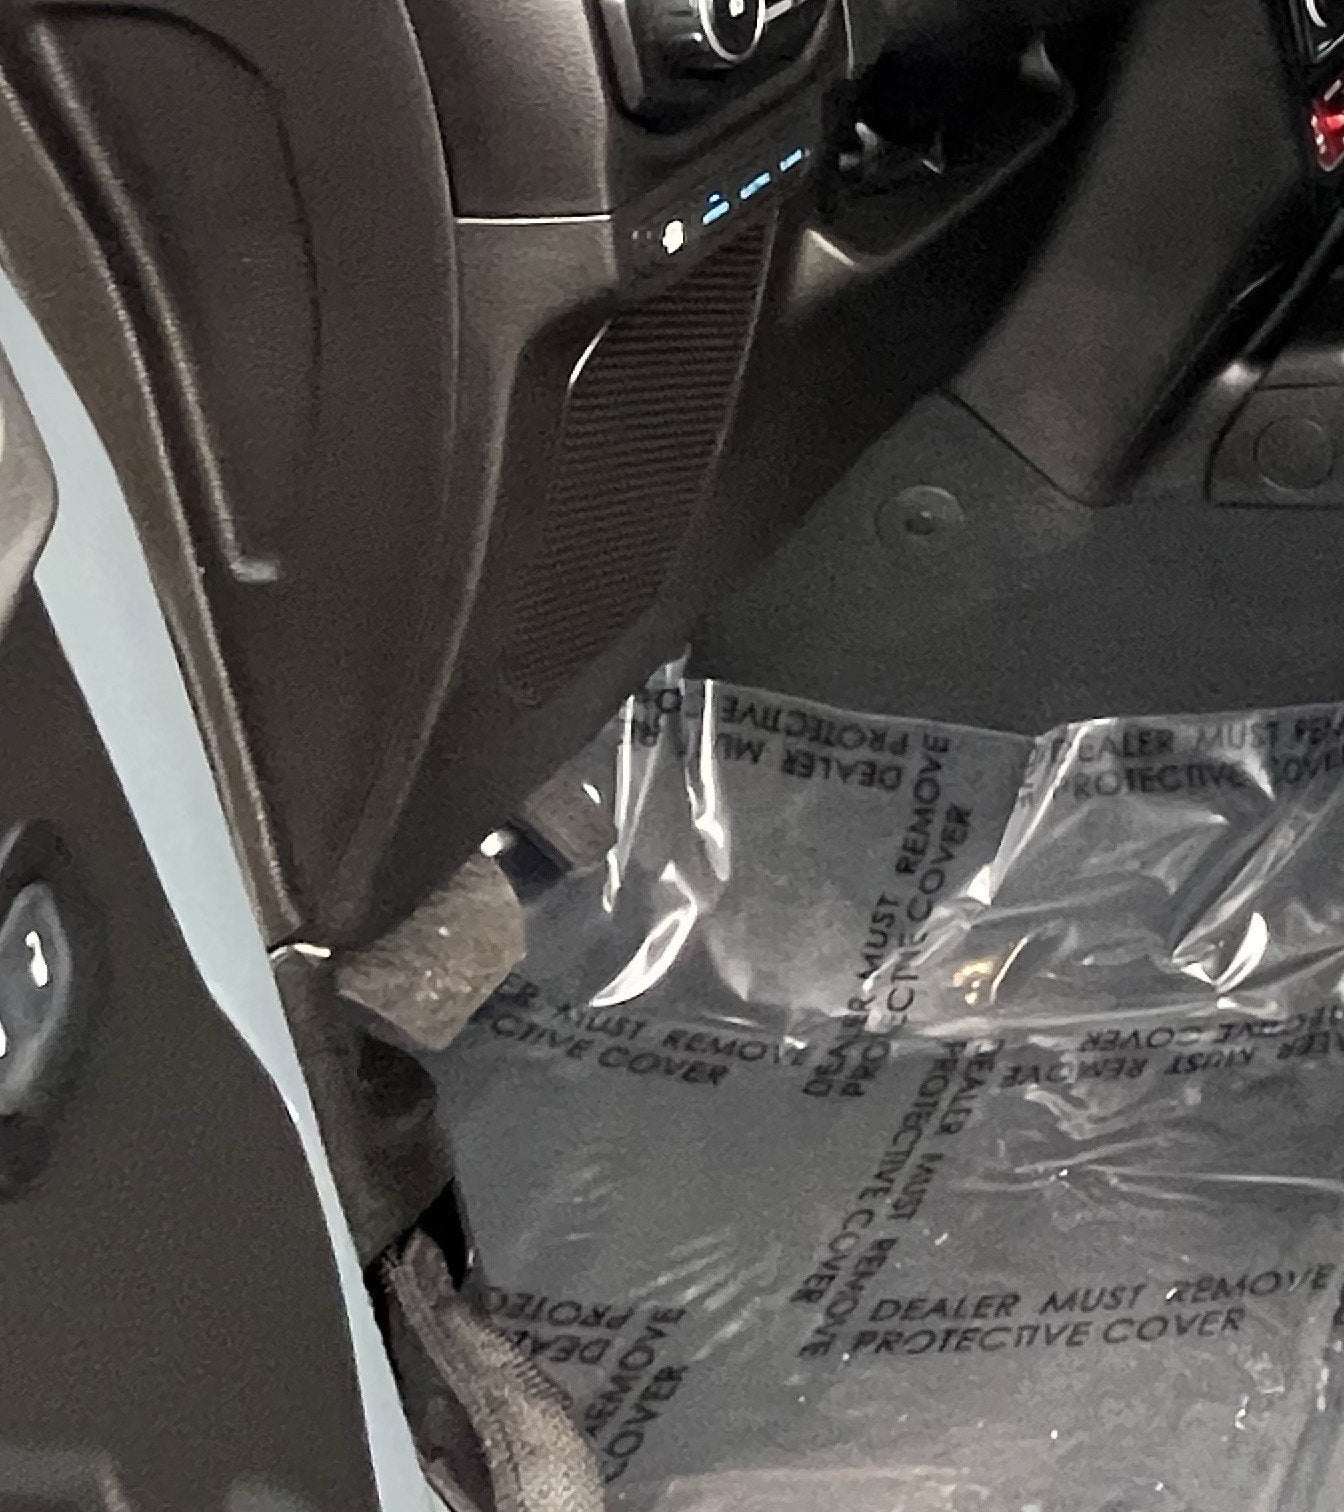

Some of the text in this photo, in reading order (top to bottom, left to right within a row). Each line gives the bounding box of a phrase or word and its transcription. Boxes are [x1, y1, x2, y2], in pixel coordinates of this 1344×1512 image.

[719, 694, 910, 756] PROTECTIVE
[780, 747, 904, 791] DEALER
[856, 890, 900, 983] MUST
[896, 732, 951, 876] REMOVE
[907, 802, 973, 924] COVER
[598, 1044, 731, 1088] COVER
[869, 1261, 1336, 1324] DEALER MUST REMOVE
[849, 1306, 1247, 1358] PROTECTIVE COVER
